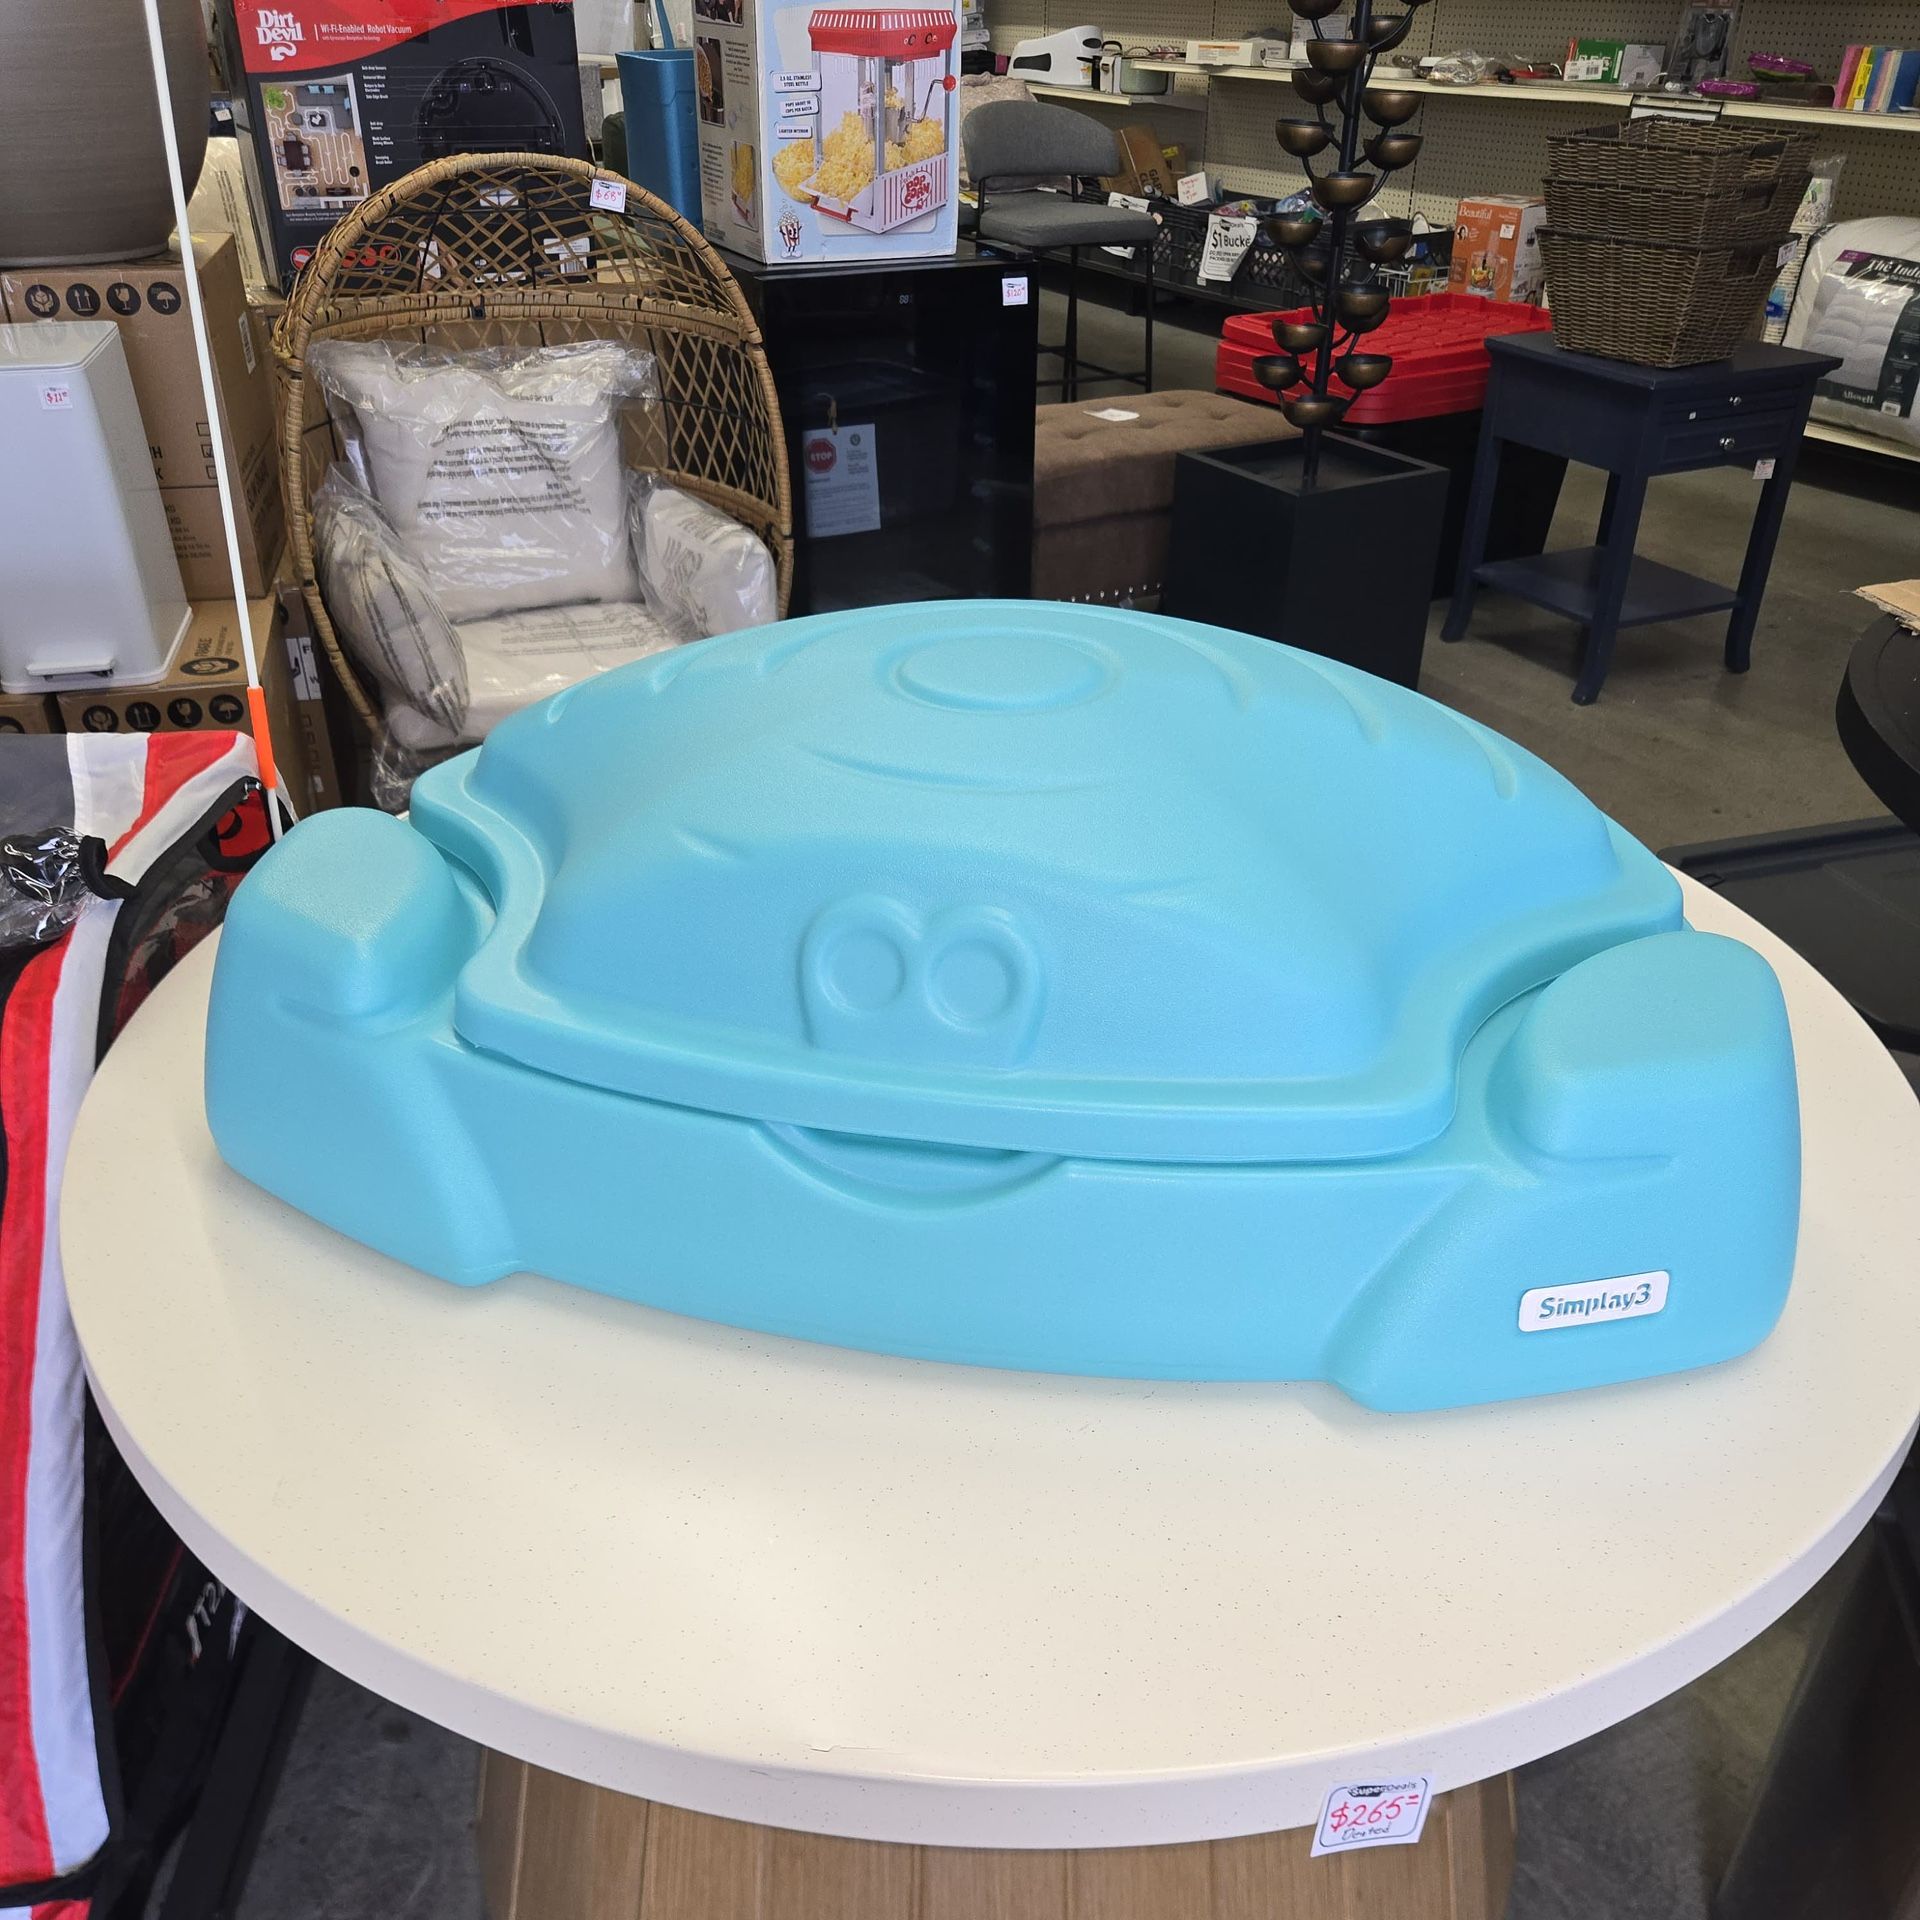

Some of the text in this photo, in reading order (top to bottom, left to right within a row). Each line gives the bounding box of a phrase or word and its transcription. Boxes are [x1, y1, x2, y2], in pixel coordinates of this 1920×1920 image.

[257, 9, 294, 28] Dirt
[256, 23, 304, 44] Devil
[320, 24, 412, 34] Wi-Fi-Enabled Robot Vacuum
[906, 175, 926, 191] POP
[904, 182, 930, 204] CORN
[1460, 206, 1492, 219] Beautiful
[1212, 230, 1222, 248] $1
[1869, 260, 1892, 273] The
[810, 451, 832, 462] STOP
[1538, 1283, 1651, 1319] Simplay3
